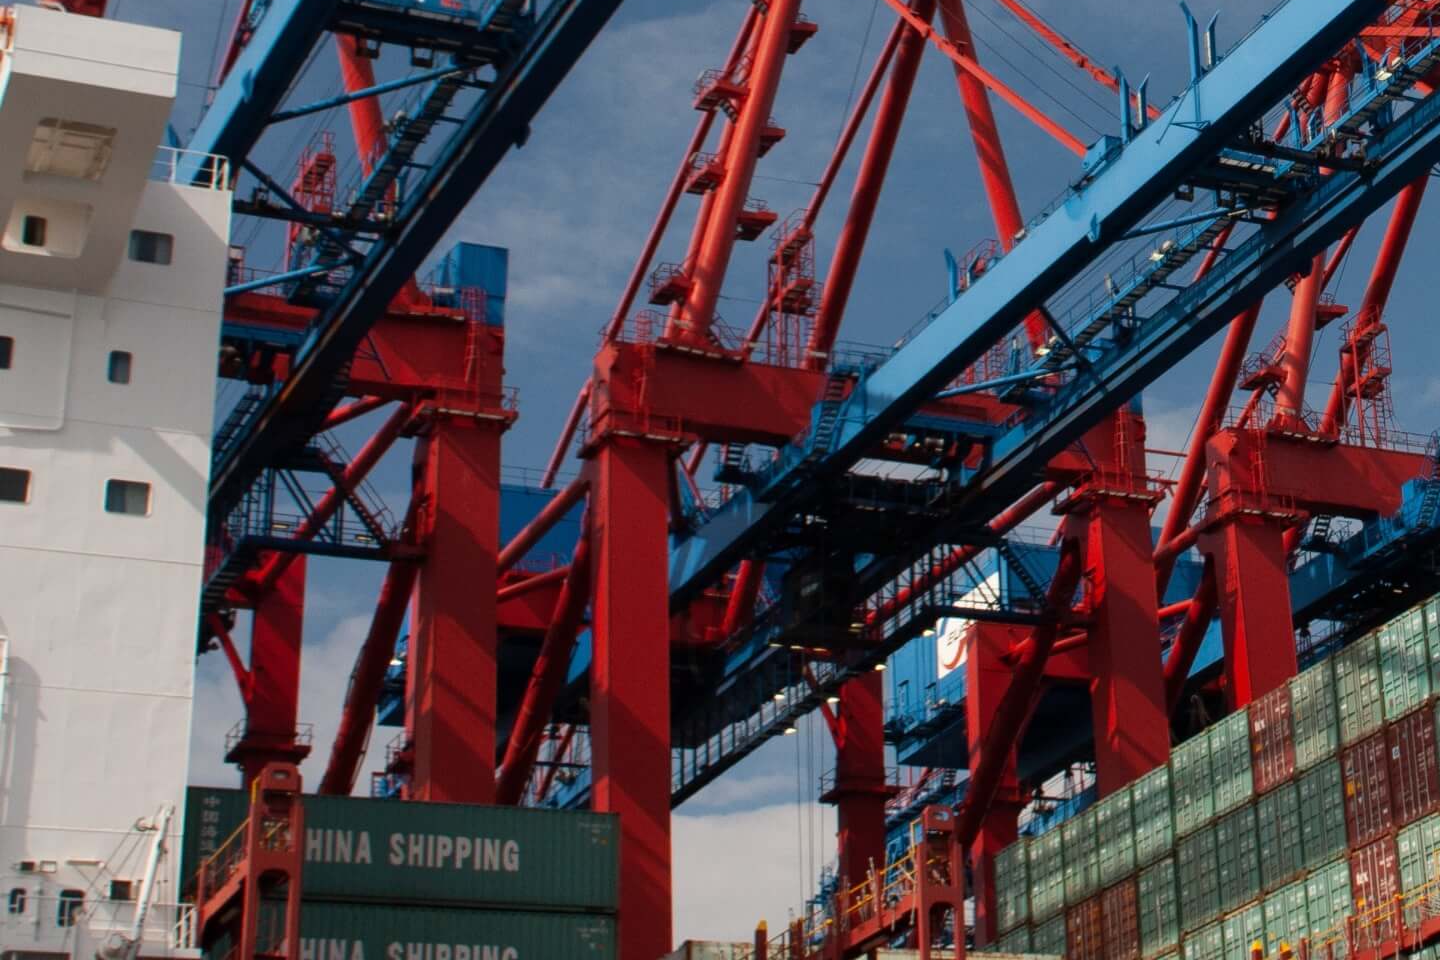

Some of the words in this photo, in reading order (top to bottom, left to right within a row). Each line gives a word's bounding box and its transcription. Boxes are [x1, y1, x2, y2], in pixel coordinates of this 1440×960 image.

[306, 828, 373, 864] HINA
[389, 832, 520, 872] SHIPPING
[300, 937, 366, 960] HINA
